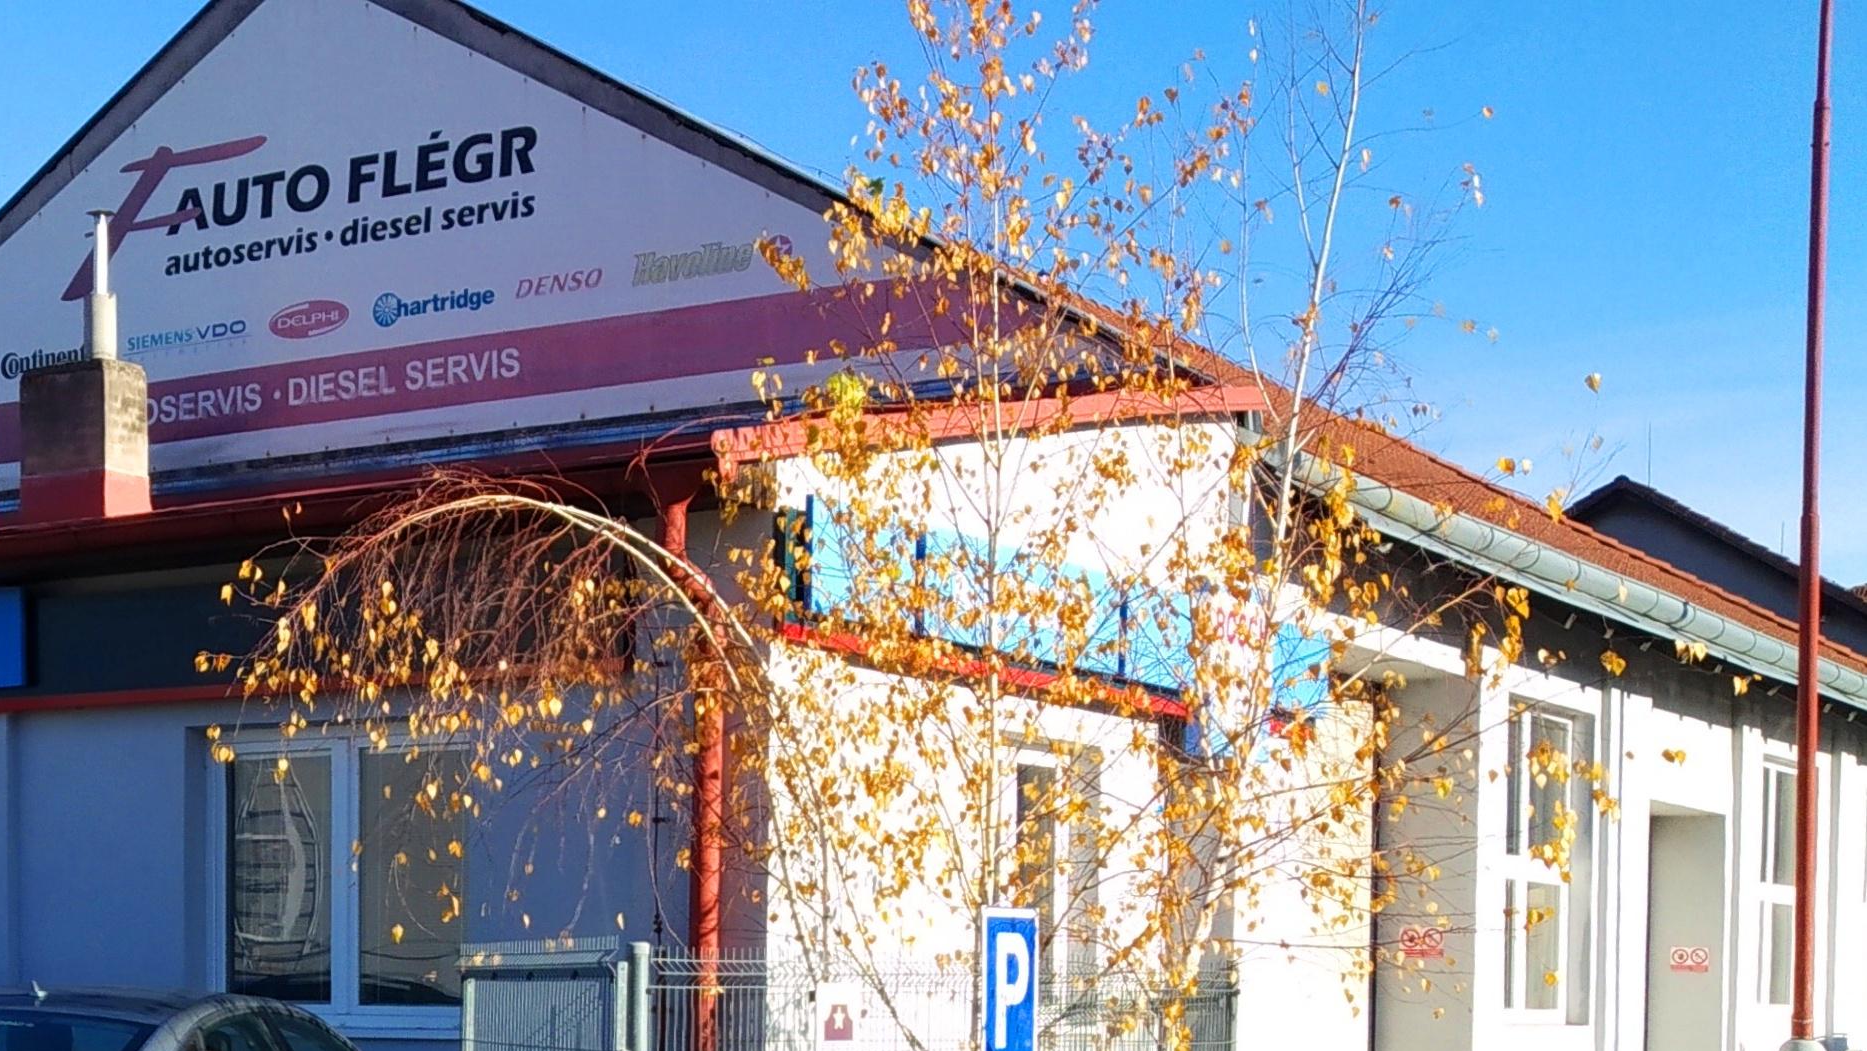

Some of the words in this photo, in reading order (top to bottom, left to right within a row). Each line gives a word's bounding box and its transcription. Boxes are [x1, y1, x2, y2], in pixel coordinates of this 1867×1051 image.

[165, 164, 331, 236] AUTO
[347, 126, 538, 203] FLÉGR
[165, 227, 318, 276] autoservis
[339, 203, 431, 248] diesel
[440, 191, 536, 230] servis
[515, 267, 603, 299] DENSO
[632, 241, 754, 287] Havoline
[276, 310, 339, 330] DELPHI
[396, 287, 495, 318] hartridge
[127, 328, 193, 352] SIEMENS
[196, 320, 247, 340] VDO
[0, 343, 85, 380] Continent
[147, 383, 262, 426] OSERVIS
[287, 365, 396, 406] DIESEL
[405, 347, 521, 392] SERVIS
[994, 931, 1030, 1050] P
